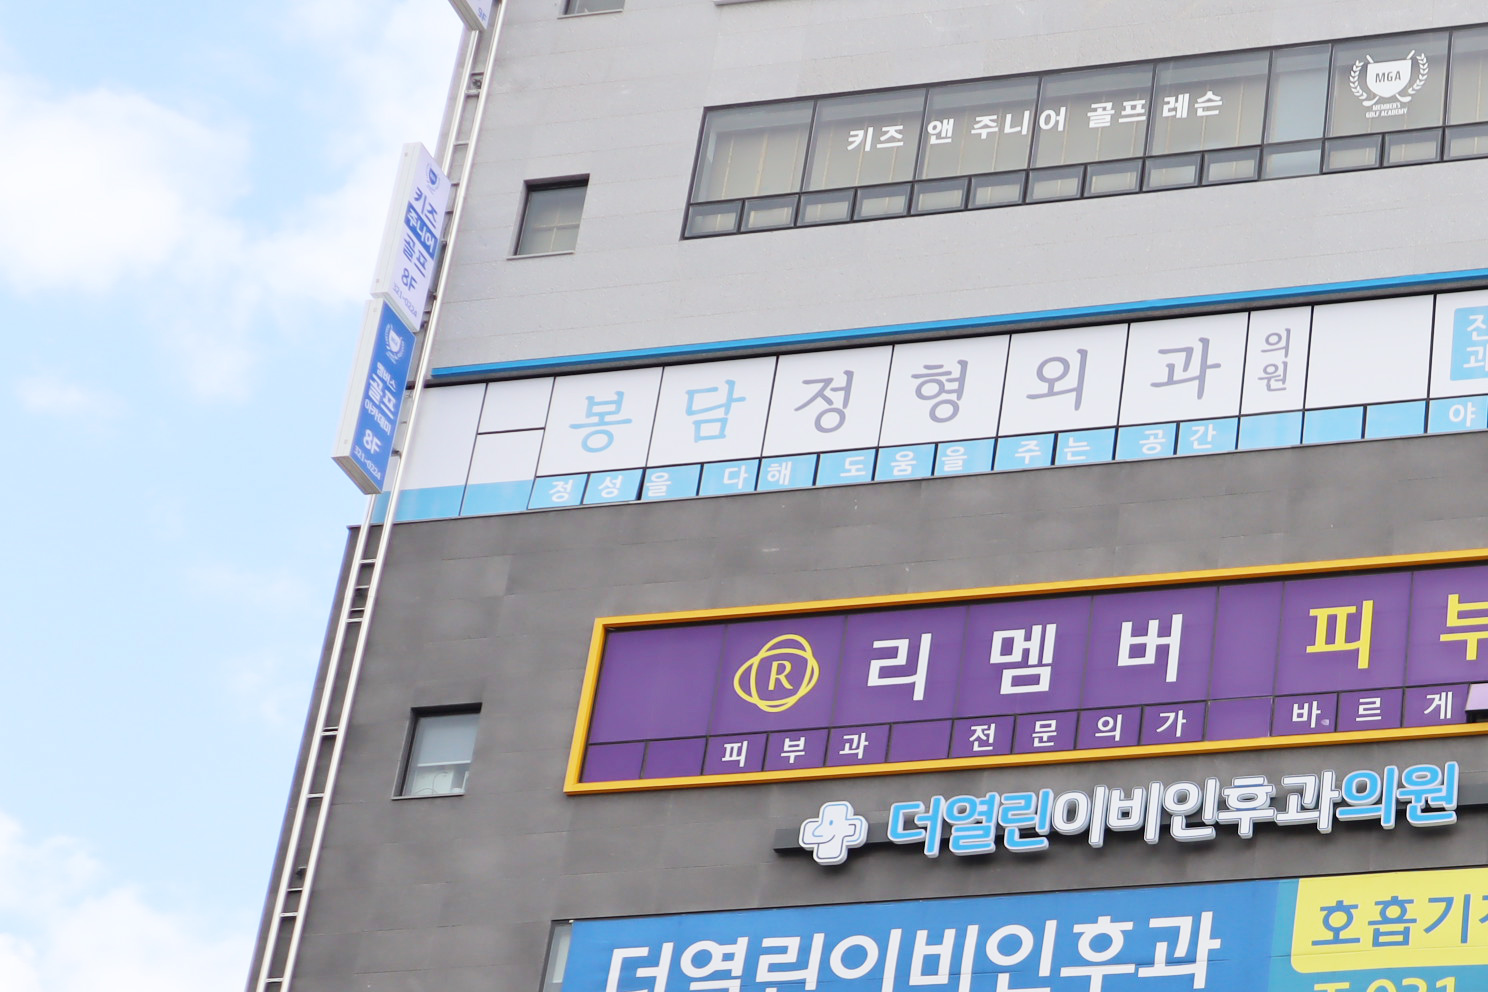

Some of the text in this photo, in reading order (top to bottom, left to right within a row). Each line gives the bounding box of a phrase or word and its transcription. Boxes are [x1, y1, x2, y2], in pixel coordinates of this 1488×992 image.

[1375, 70, 1402, 83] MGA
[846, 90, 1224, 153] 키즈 앤 주니어 골프 레슨
[406, 207, 435, 254] 주니어
[414, 186, 438, 230] 키즈
[403, 233, 428, 278] 골프
[401, 268, 418, 291] 8F
[369, 374, 396, 420] 골프
[363, 429, 382, 455] 8F
[547, 425, 1217, 503] 정성을 다해 도움을 주는 공간
[767, 659, 795, 692] R
[867, 614, 1183, 701] 리멤버
[722, 733, 869, 767] 피부과
[969, 708, 1187, 752] 전문의가
[1292, 690, 1453, 729] 바르게
[887, 761, 1459, 857] 더열린이비인후과의원
